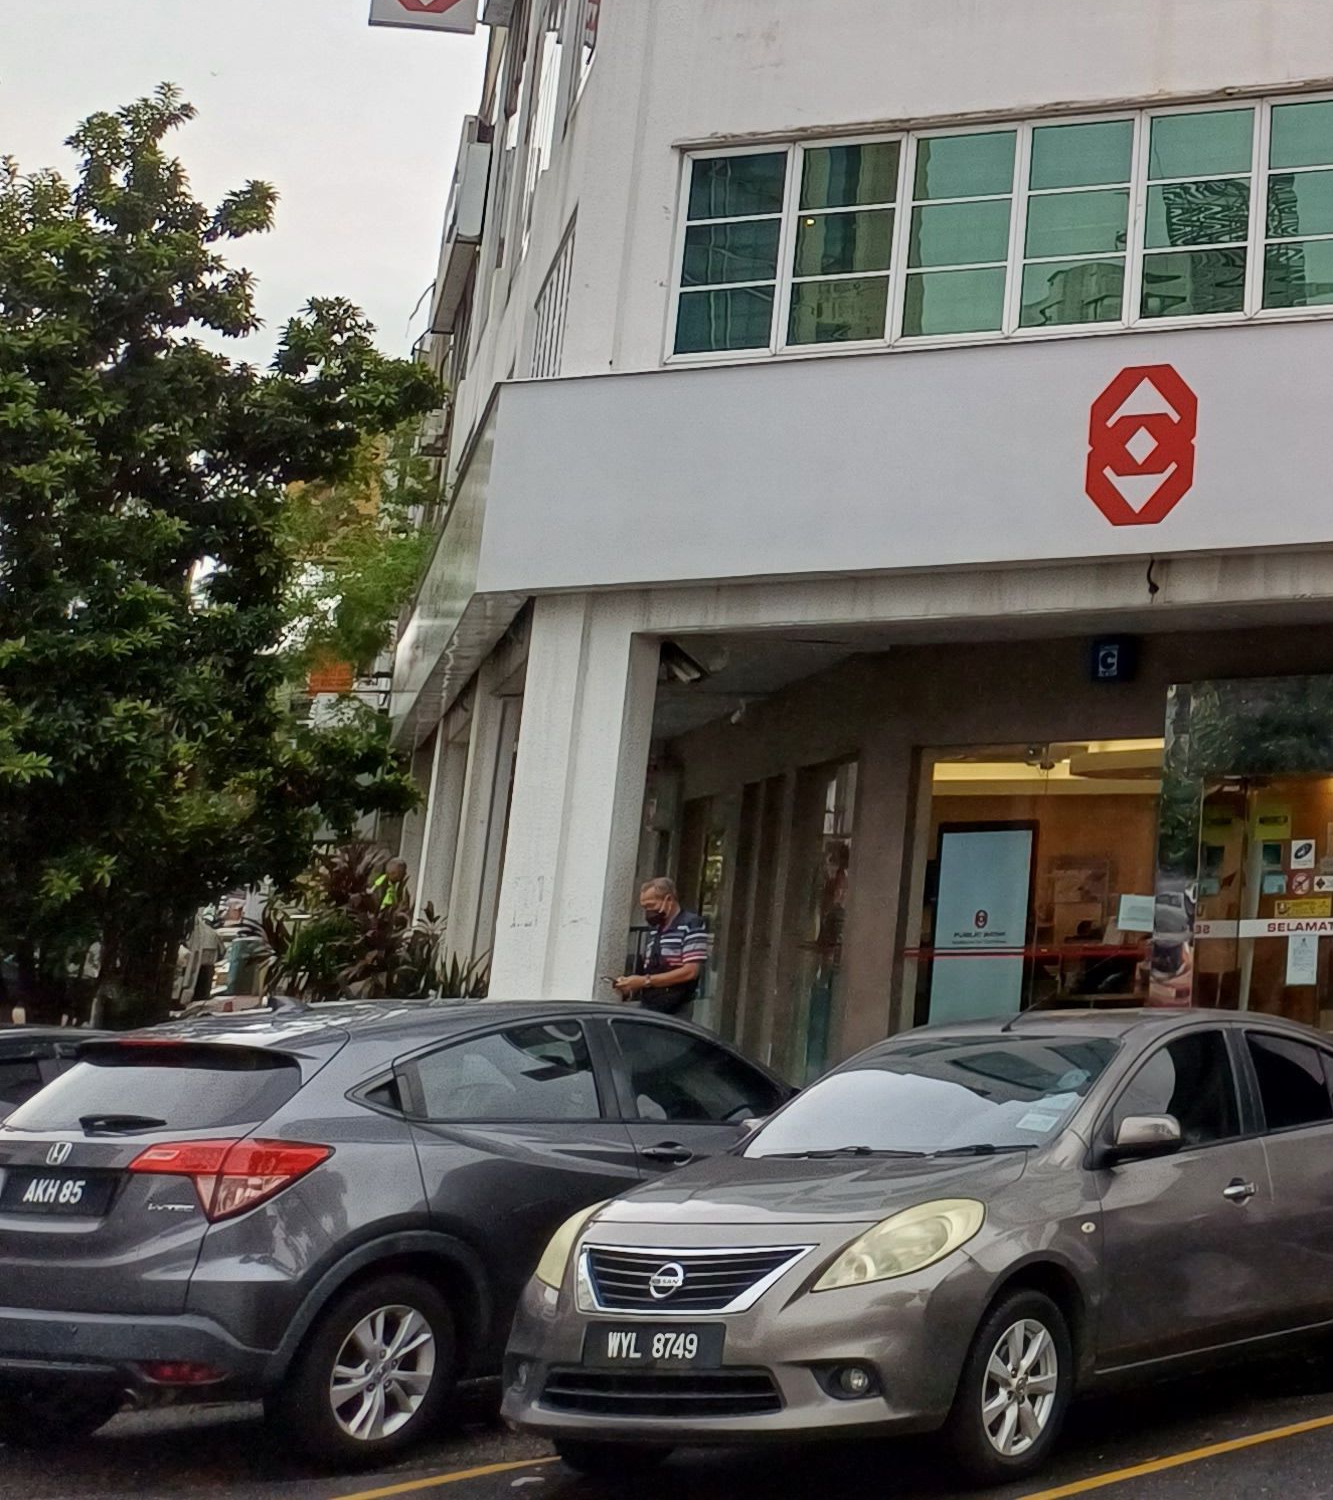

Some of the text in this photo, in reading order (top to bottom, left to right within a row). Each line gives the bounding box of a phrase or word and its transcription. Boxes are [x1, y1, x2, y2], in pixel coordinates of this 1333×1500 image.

[23, 1179, 86, 1203] AKH 85
[607, 1331, 698, 1359] WYL 8749
